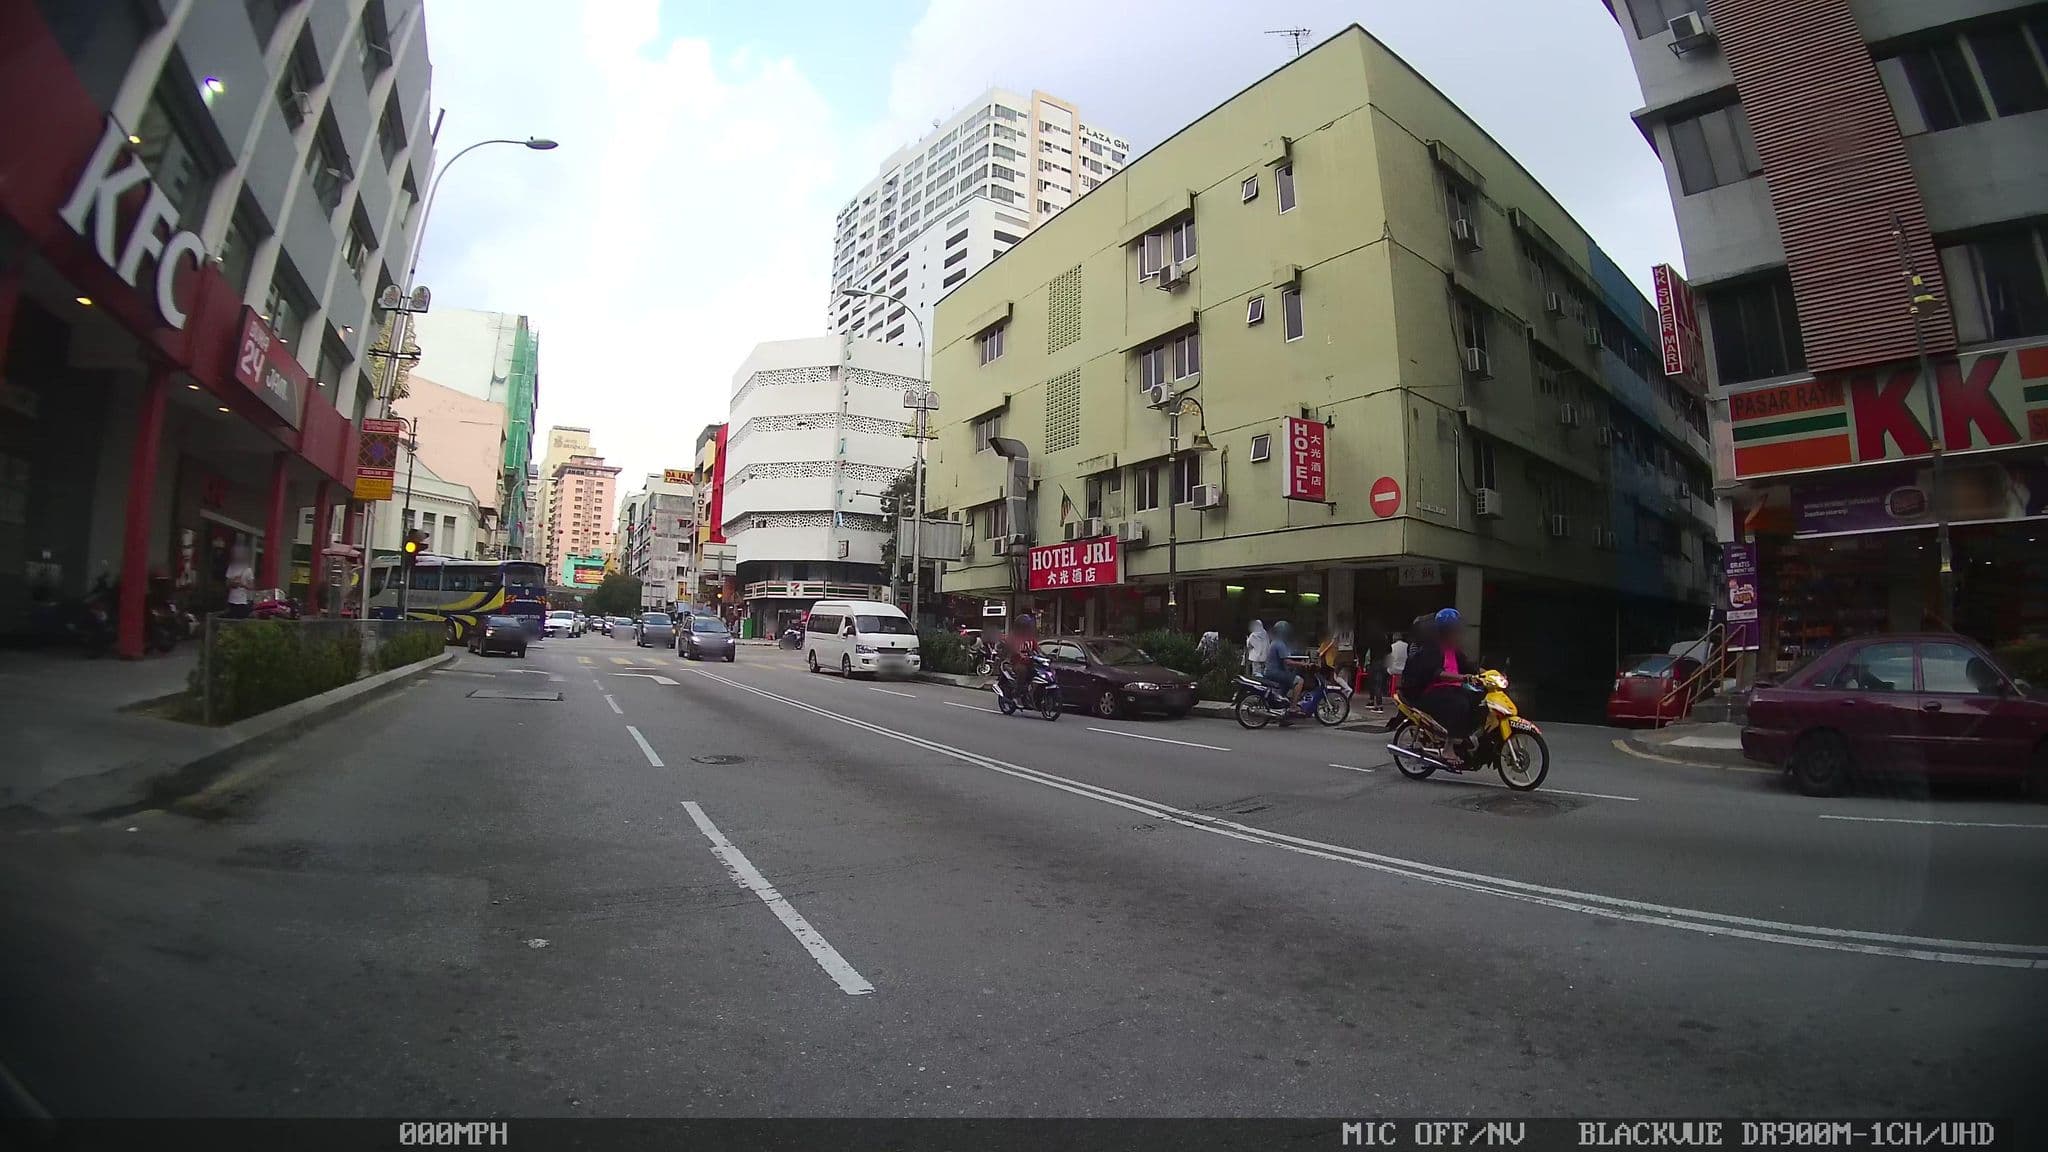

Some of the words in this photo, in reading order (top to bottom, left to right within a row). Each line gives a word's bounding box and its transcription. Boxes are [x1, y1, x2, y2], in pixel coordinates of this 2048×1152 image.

[1079, 124, 1111, 144] PLAZA
[57, 115, 207, 329] KFC
[1654, 266, 1667, 286] KK
[1657, 289, 1673, 333] SUPER
[241, 339, 265, 382] 24
[1664, 336, 1677, 372] MART
[1734, 390, 1791, 417] PASAR
[1851, 351, 2021, 461] KK
[1294, 422, 1308, 494] HOTEL
[1032, 546, 1077, 571] HOTEL
[1083, 541, 1113, 565] JRL
[1047, 567, 1096, 585] 大光酒店
